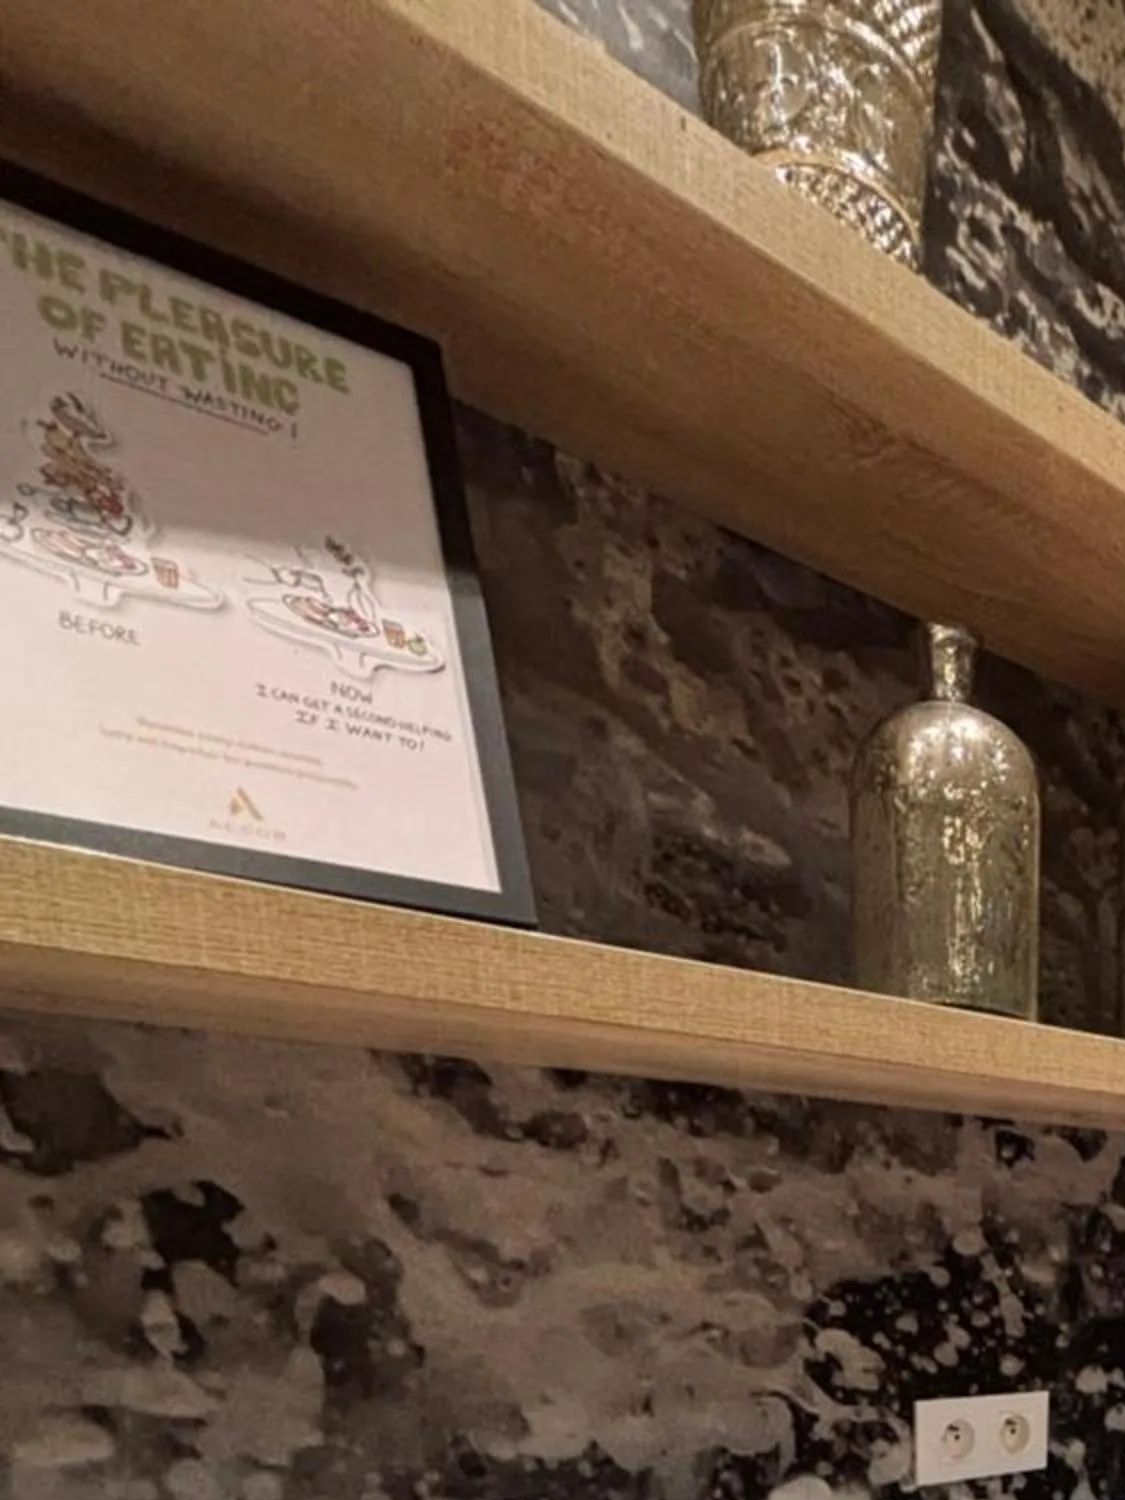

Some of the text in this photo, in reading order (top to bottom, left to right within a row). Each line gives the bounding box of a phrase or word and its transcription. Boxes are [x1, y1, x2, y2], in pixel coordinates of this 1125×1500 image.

[0, 226, 351, 395] HE PLEASURE
[37, 295, 300, 416] OF EATING
[53, 336, 168, 391] WITHOUT
[58, 609, 143, 647] BEFORE
[255, 683, 268, 699] I
[271, 686, 300, 705] CAN
[302, 695, 330, 713] GET
[333, 704, 344, 715] A
[330, 680, 374, 705] NOW
[294, 709, 426, 753] IF I WANT TO!
